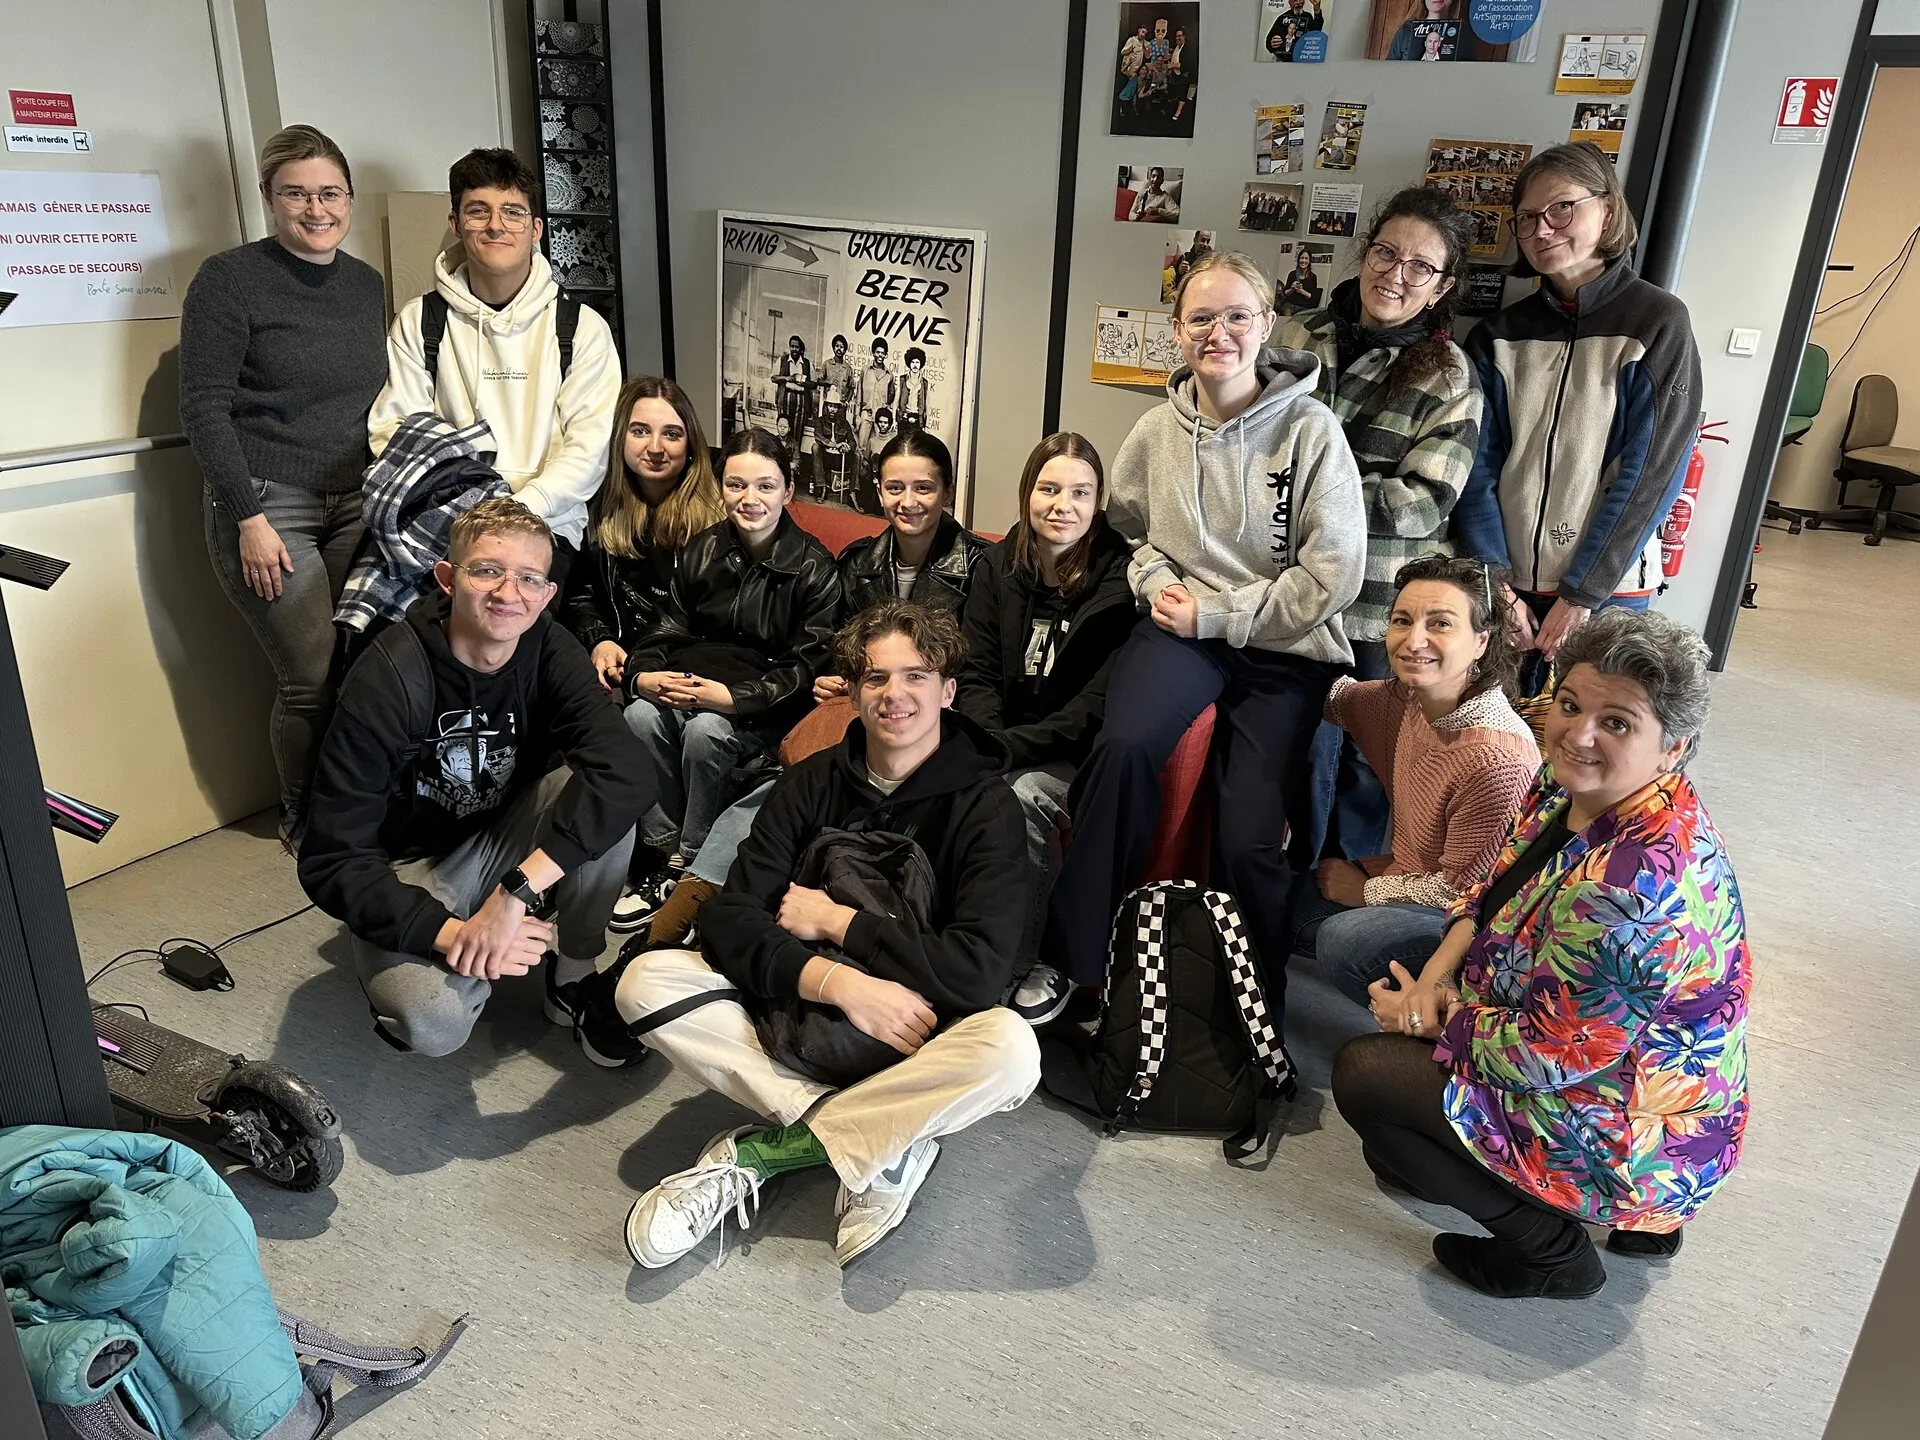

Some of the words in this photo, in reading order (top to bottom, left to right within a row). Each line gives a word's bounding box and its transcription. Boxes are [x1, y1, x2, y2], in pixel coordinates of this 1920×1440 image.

[1477, 3, 1487, 11] de
[1502, 13, 1533, 21] soutient
[16, 97, 36, 105] PORTE
[36, 98, 57, 107] COUPE
[57, 100, 69, 108] FEU
[11, 134, 33, 142] sortie
[36, 135, 69, 144] interdite
[43, 201, 83, 213] GÊNER
[85, 203, 99, 213] LE
[101, 203, 151, 214] PASSAGE
[0, 234, 12, 244] NI
[15, 234, 61, 244] OUVRIR
[63, 233, 99, 243] CETTE
[101, 233, 137, 243] PORTE
[847, 232, 968, 274] GROCERIES
[6, 264, 66, 278] (PASSAGE
[69, 264, 85, 273] DE
[87, 262, 143, 274] SECOURS)
[855, 268, 950, 309] BEER
[854, 303, 951, 346] WINE
